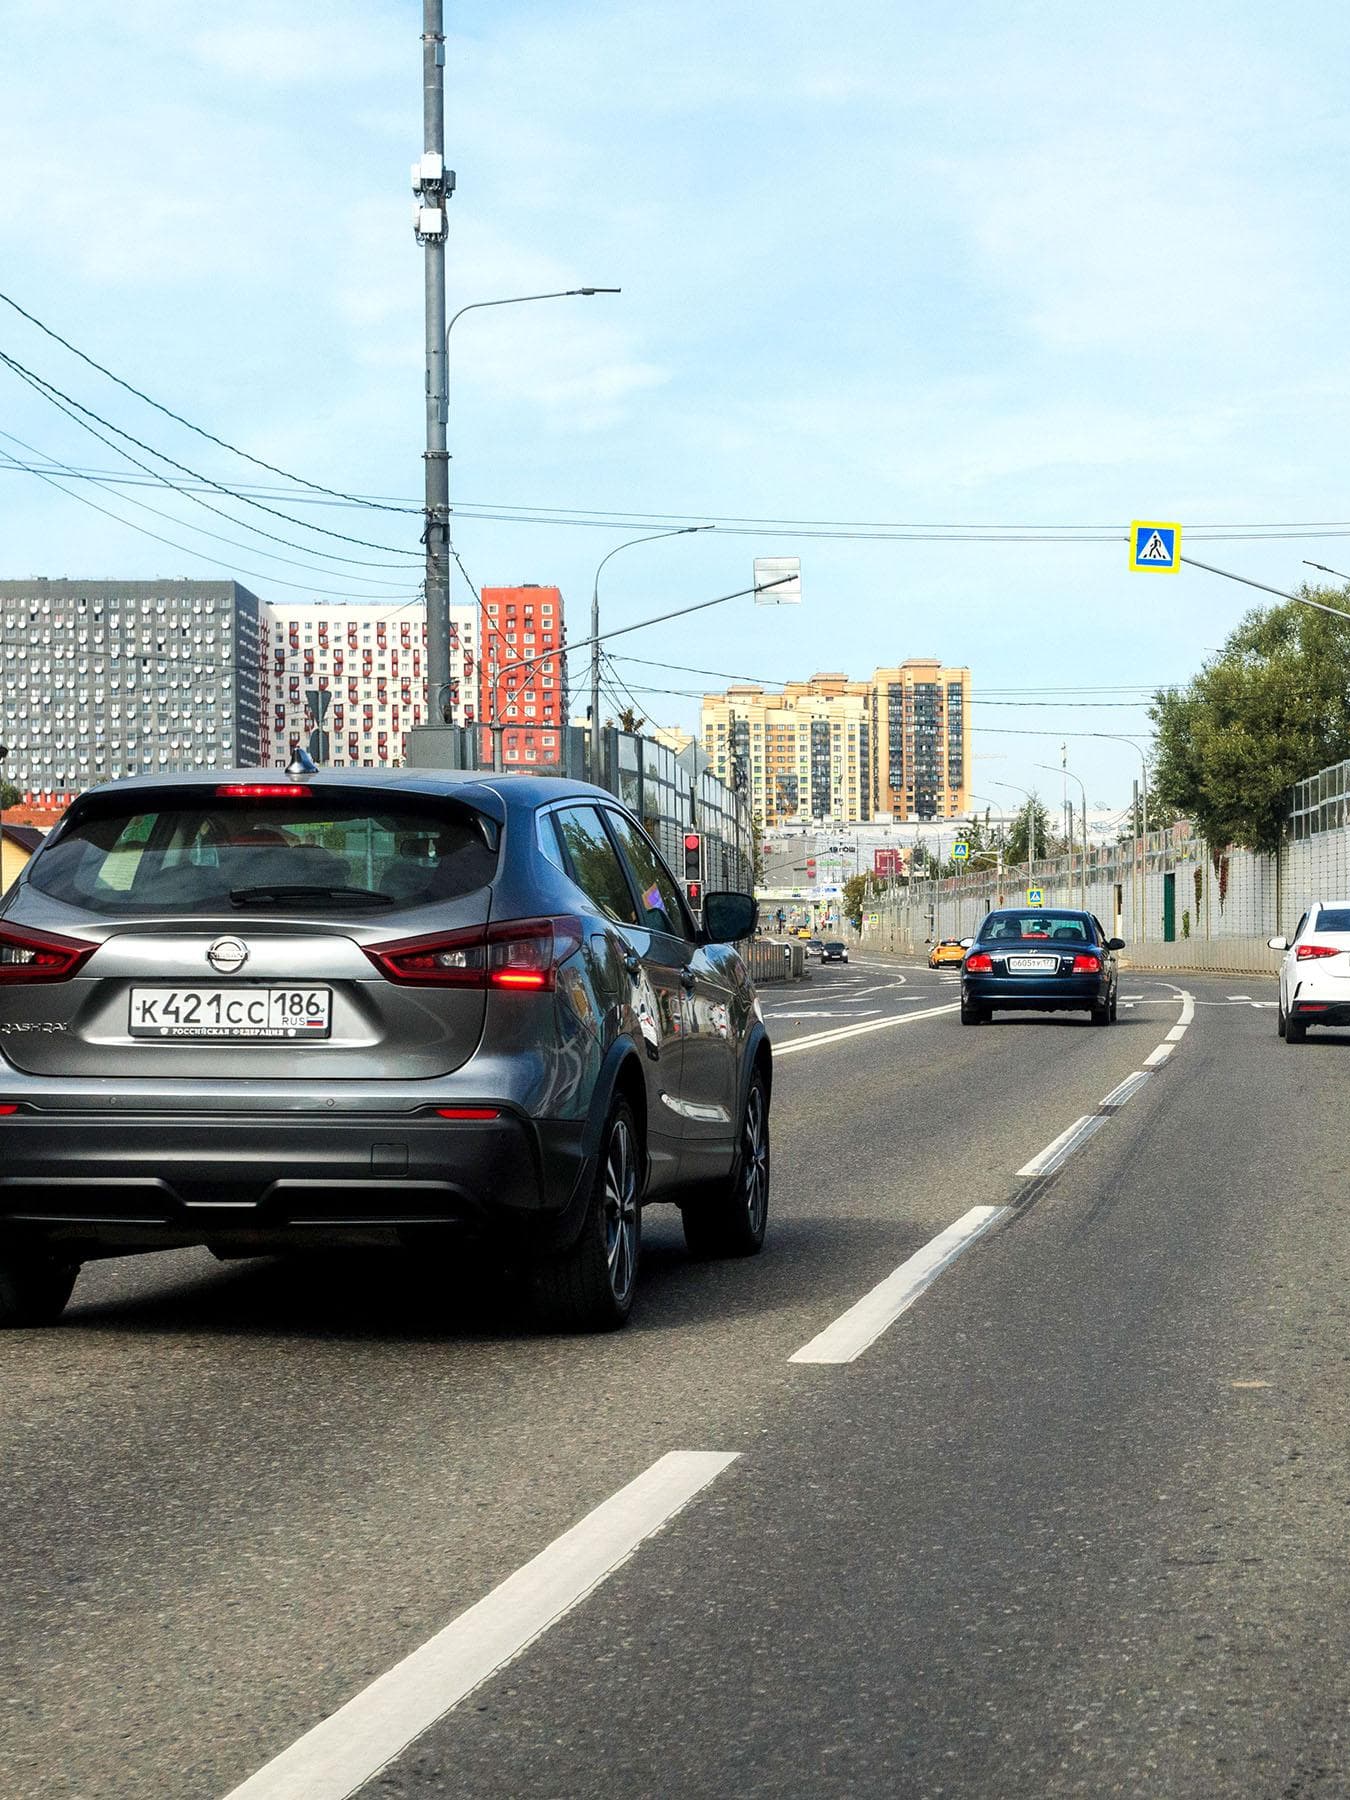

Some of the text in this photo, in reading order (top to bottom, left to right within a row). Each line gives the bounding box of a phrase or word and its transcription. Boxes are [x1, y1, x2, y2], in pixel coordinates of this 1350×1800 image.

[274, 993, 320, 1016] 186
[282, 1017, 305, 1026] RUS
[172, 1027, 284, 1037] РОССИЙСКАЯ ФЕДЕРАЦИЯ
